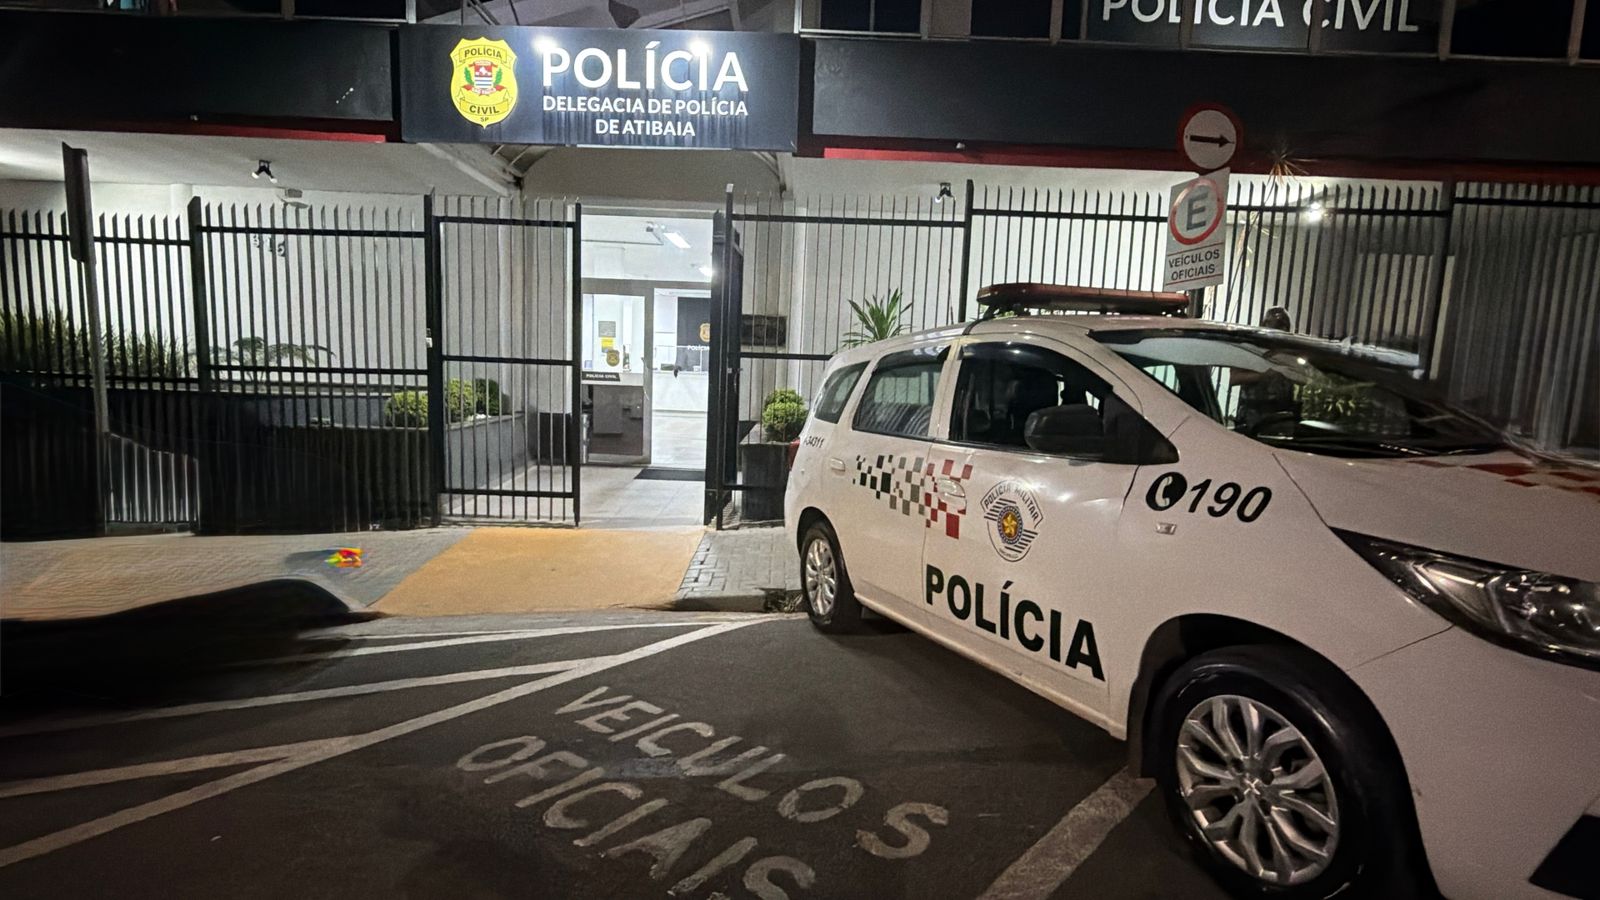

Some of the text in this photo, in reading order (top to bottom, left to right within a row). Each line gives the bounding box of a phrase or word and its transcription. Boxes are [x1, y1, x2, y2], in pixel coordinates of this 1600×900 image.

[464, 46, 502, 59] POLÍCIA
[543, 41, 749, 92] POLÍCIA
[469, 105, 500, 115] CIVIL
[543, 95, 749, 116] DELEGACIA DE POLÍCIA
[595, 119, 695, 136] DE ATIBAIA
[1186, 191, 1208, 231] E
[1168, 249, 1220, 268] VEÍCULOS
[1171, 263, 1215, 281] OFICIAIS
[1014, 485, 1040, 521] MILITAR
[1189, 478, 1273, 524] 190
[925, 564, 1106, 682] POLÍCIA
[554, 686, 950, 860] VEICULOS
[456, 735, 816, 900] OFICIAIS
